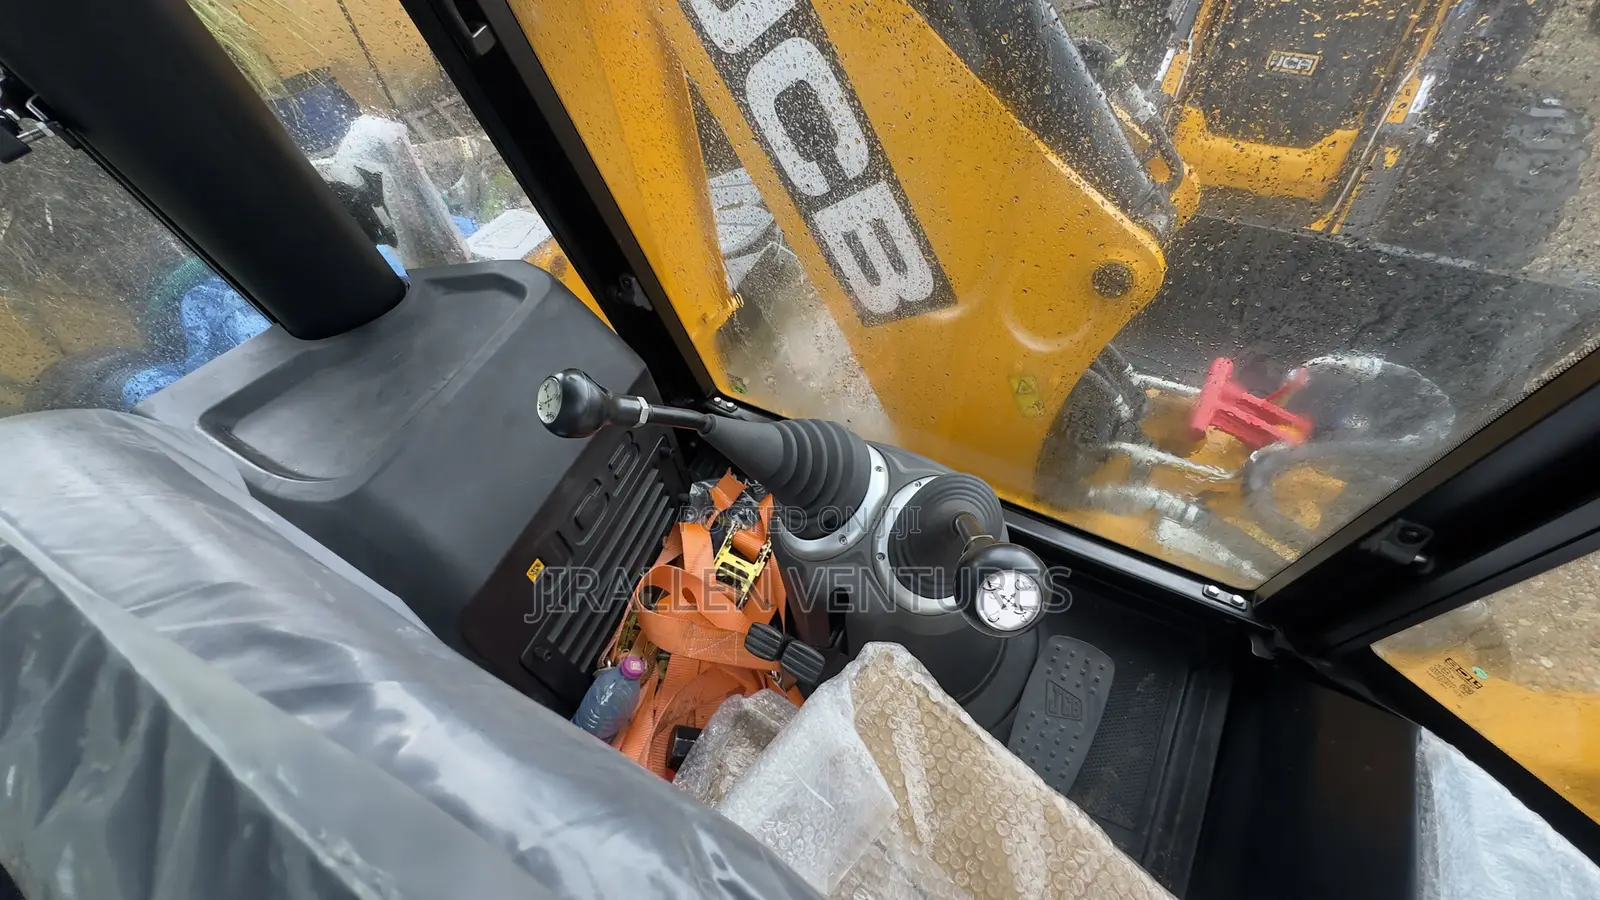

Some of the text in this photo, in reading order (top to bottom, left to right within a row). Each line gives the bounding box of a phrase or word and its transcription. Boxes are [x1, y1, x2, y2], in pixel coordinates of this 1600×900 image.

[1270, 55, 1314, 71] JCB
[691, 0, 935, 314] JCB
[544, 430, 641, 595] JCB
[1047, 684, 1081, 717] JCB
